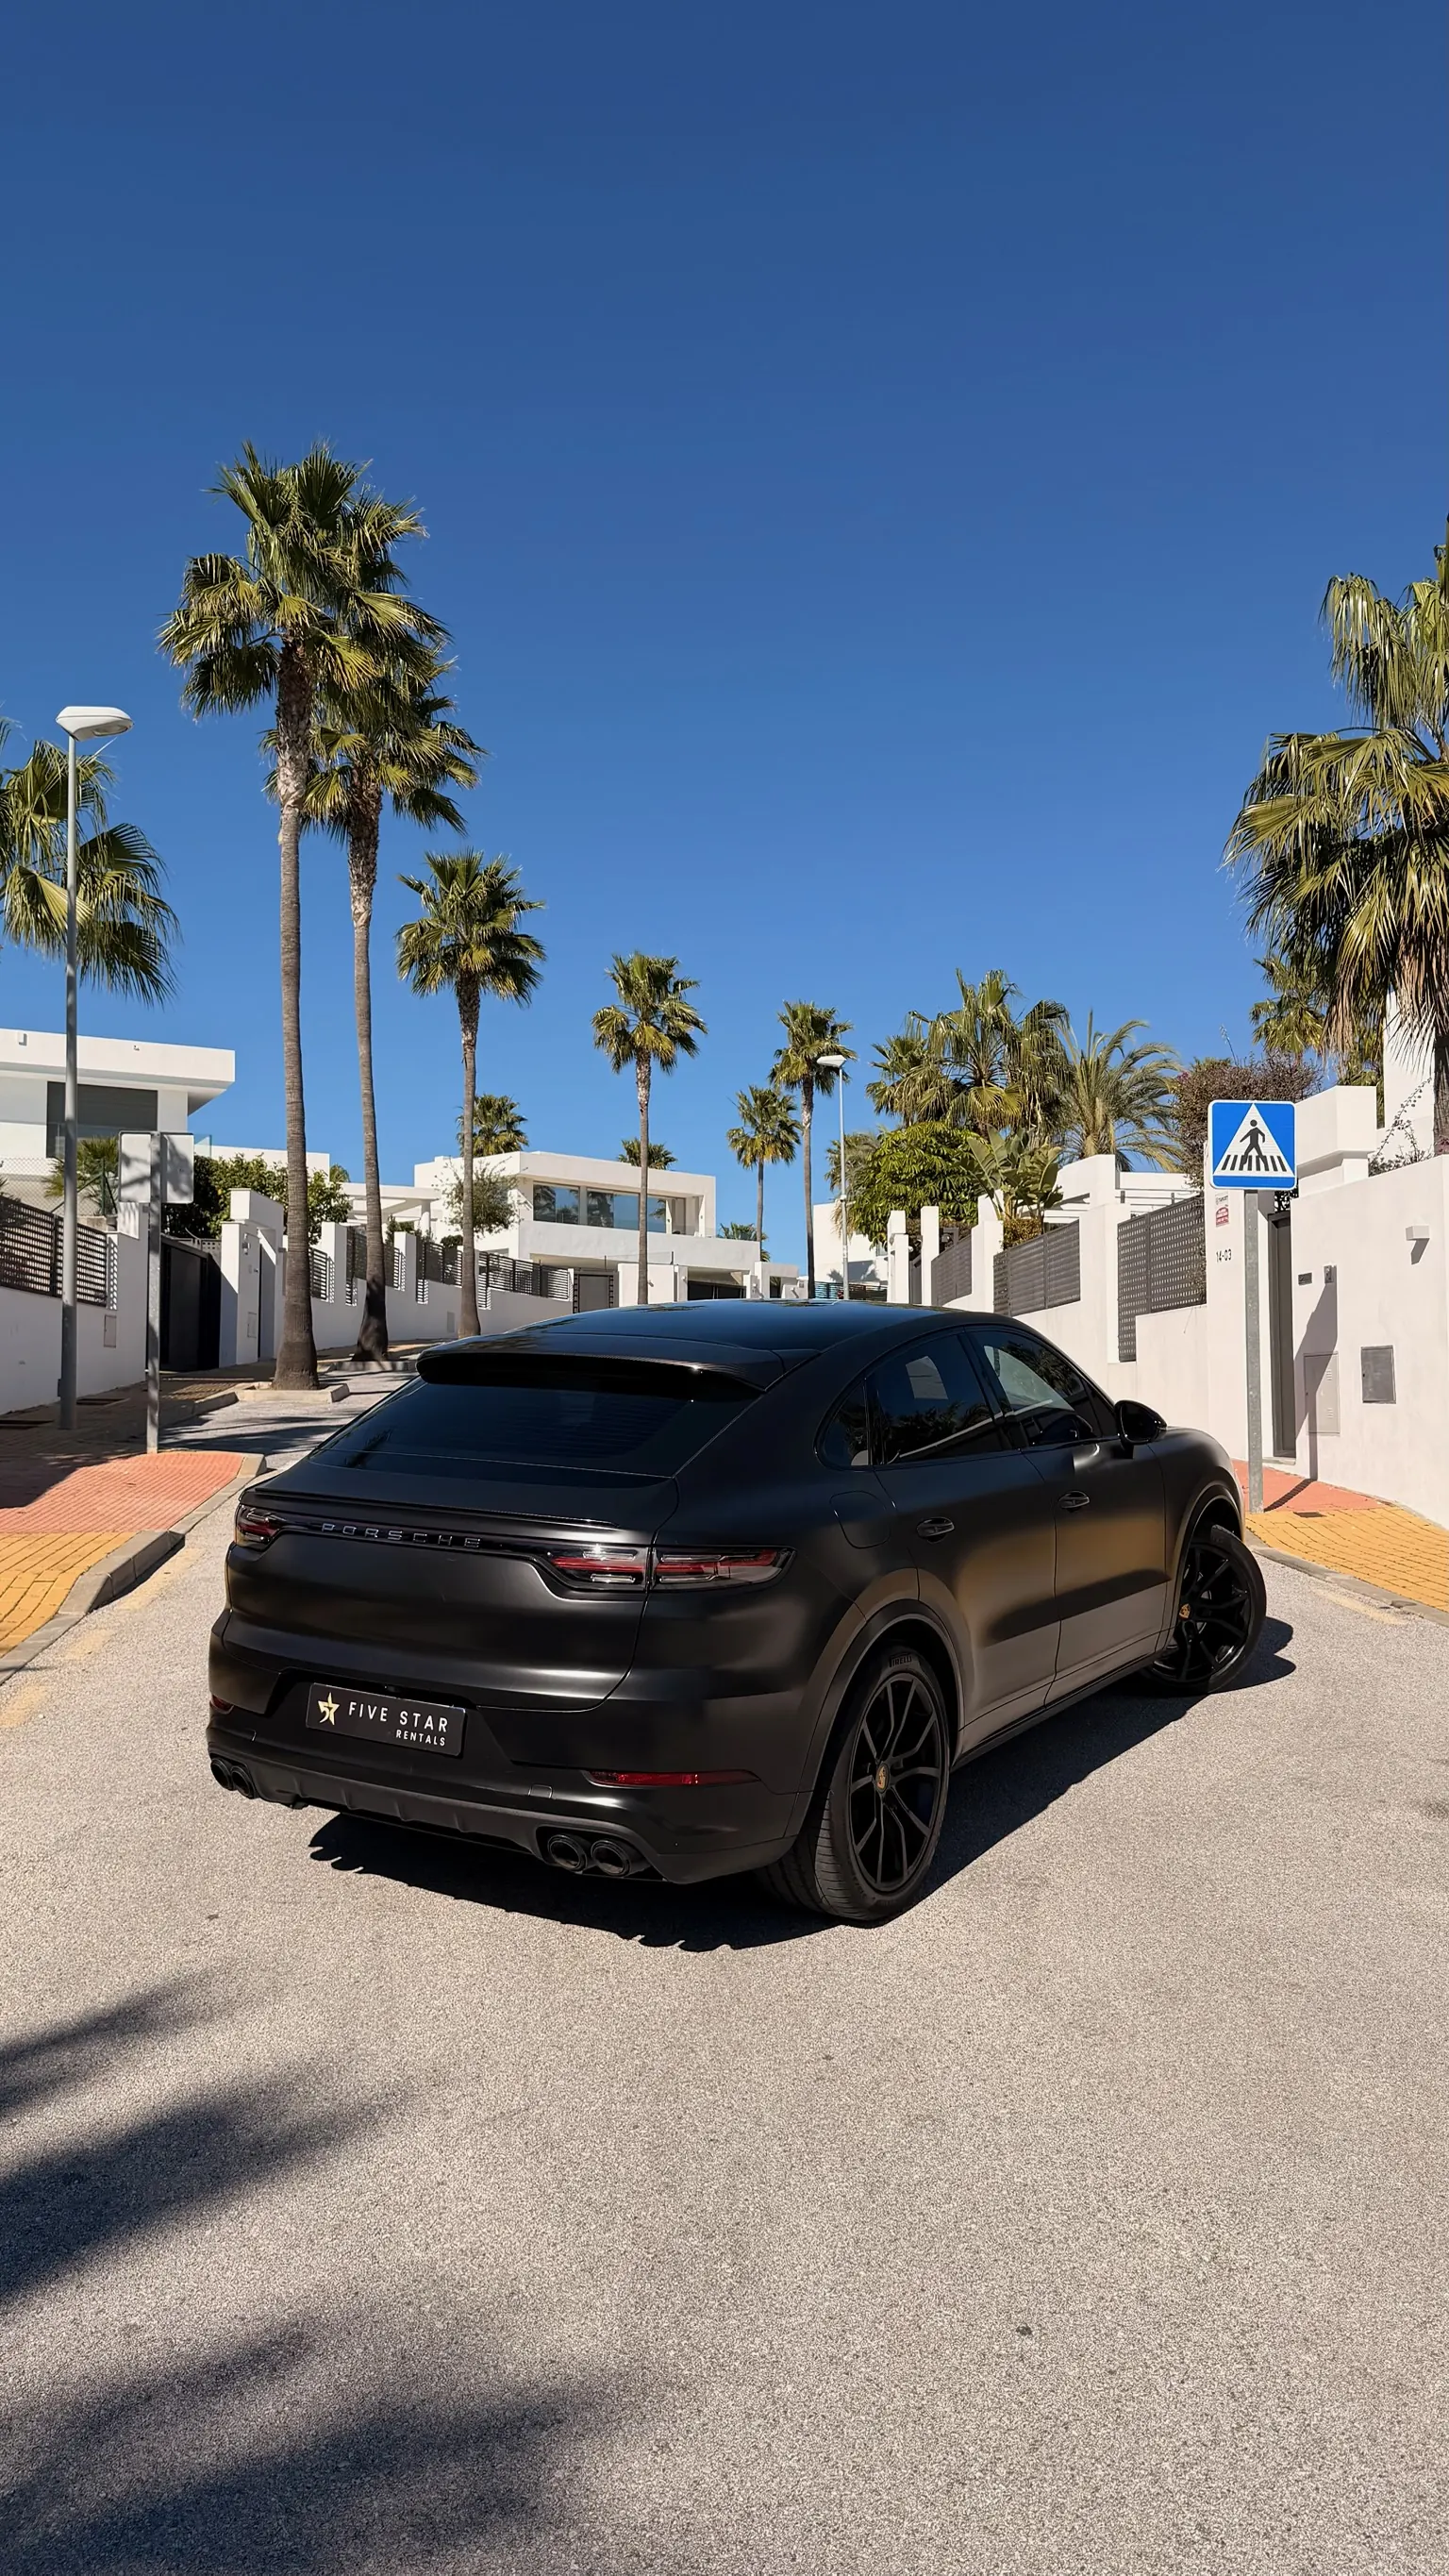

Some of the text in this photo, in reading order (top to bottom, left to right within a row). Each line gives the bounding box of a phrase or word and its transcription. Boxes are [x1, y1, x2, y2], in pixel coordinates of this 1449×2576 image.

[321, 1522, 481, 1548] PORSCHE
[348, 1701, 448, 1732] FIVE STAR
[395, 1729, 446, 1747] RENTALS
